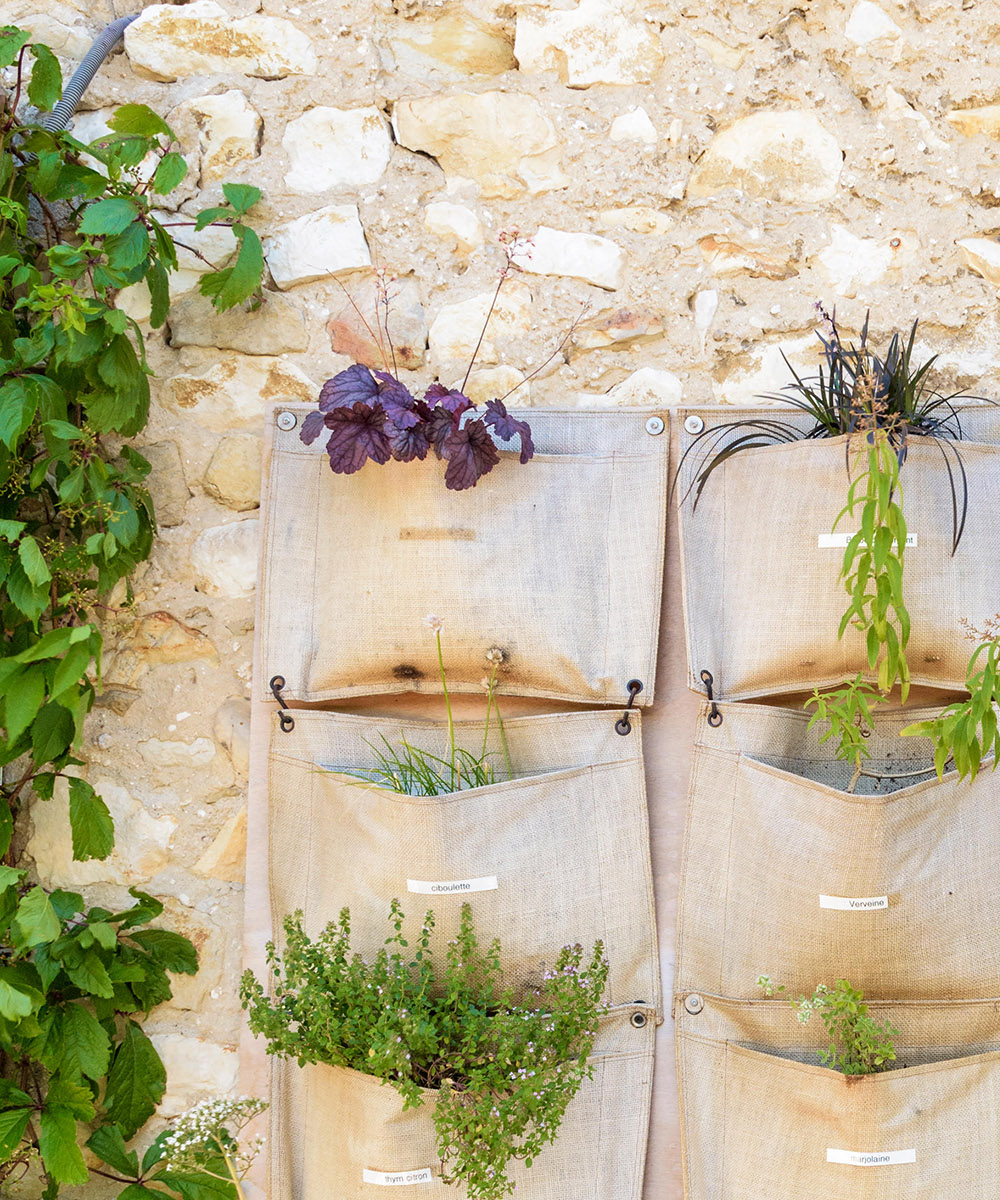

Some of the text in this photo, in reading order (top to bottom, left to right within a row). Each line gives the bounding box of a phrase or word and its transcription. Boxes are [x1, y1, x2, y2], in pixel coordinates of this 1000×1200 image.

[431, 883, 471, 892] ciboulette
[849, 899, 885, 908] Verveine
[385, 1172, 428, 1184] thym citron
